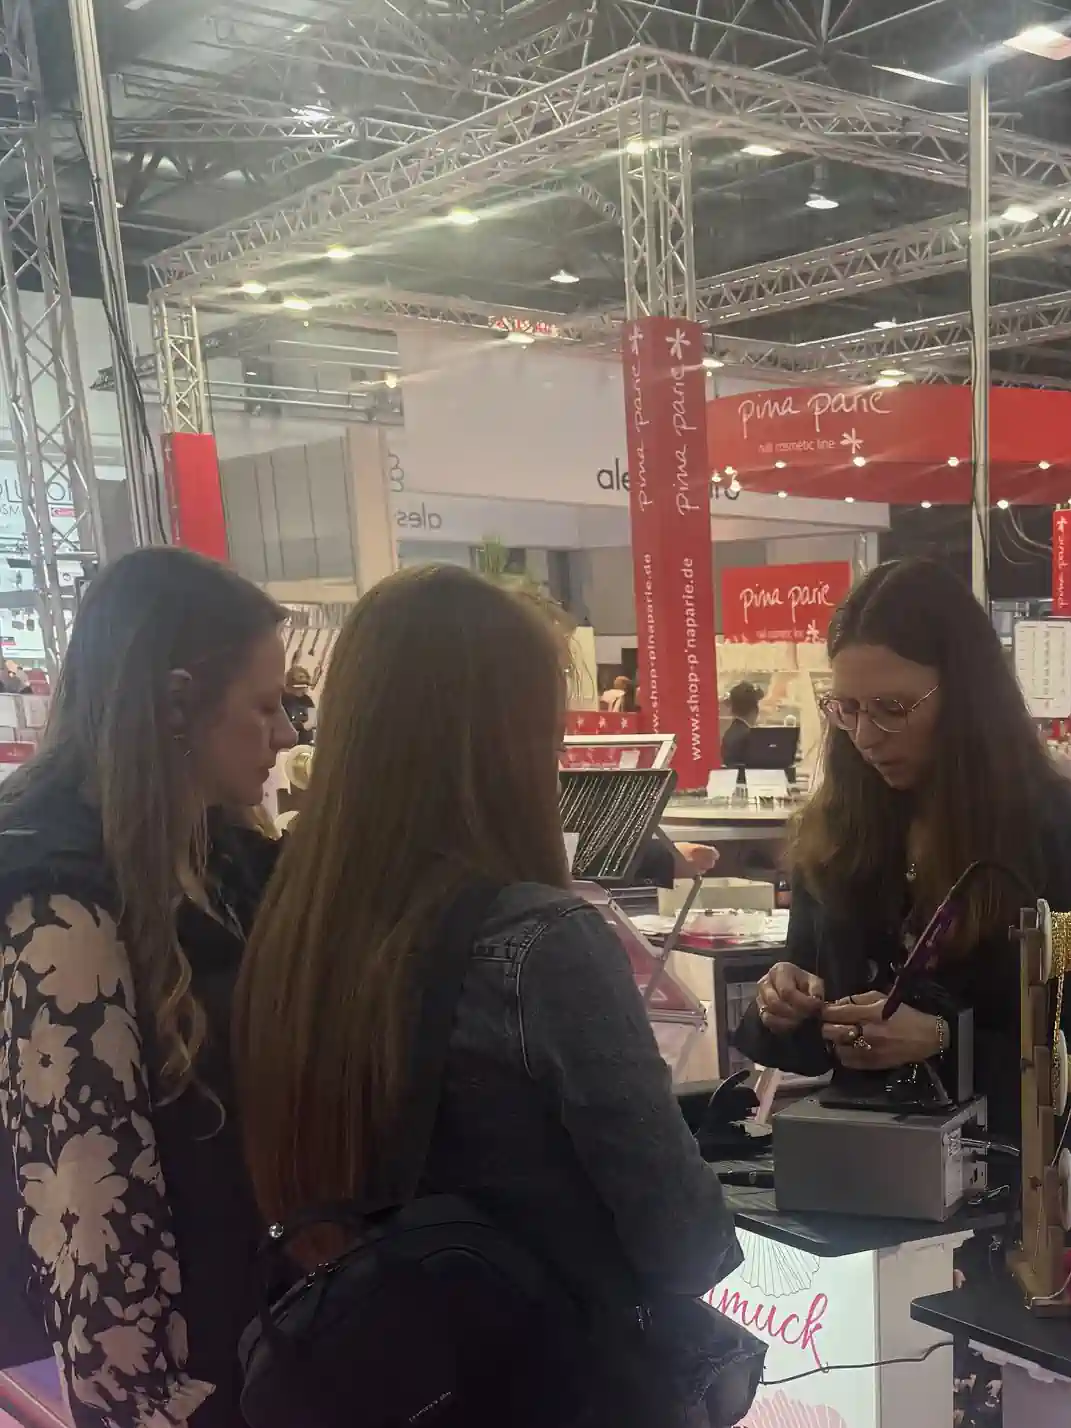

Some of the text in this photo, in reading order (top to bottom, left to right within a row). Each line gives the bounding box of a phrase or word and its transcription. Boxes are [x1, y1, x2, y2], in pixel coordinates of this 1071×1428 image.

[738, 394, 800, 439] pina
[671, 367, 700, 516] pina parie
[740, 580, 836, 624] pina parie
